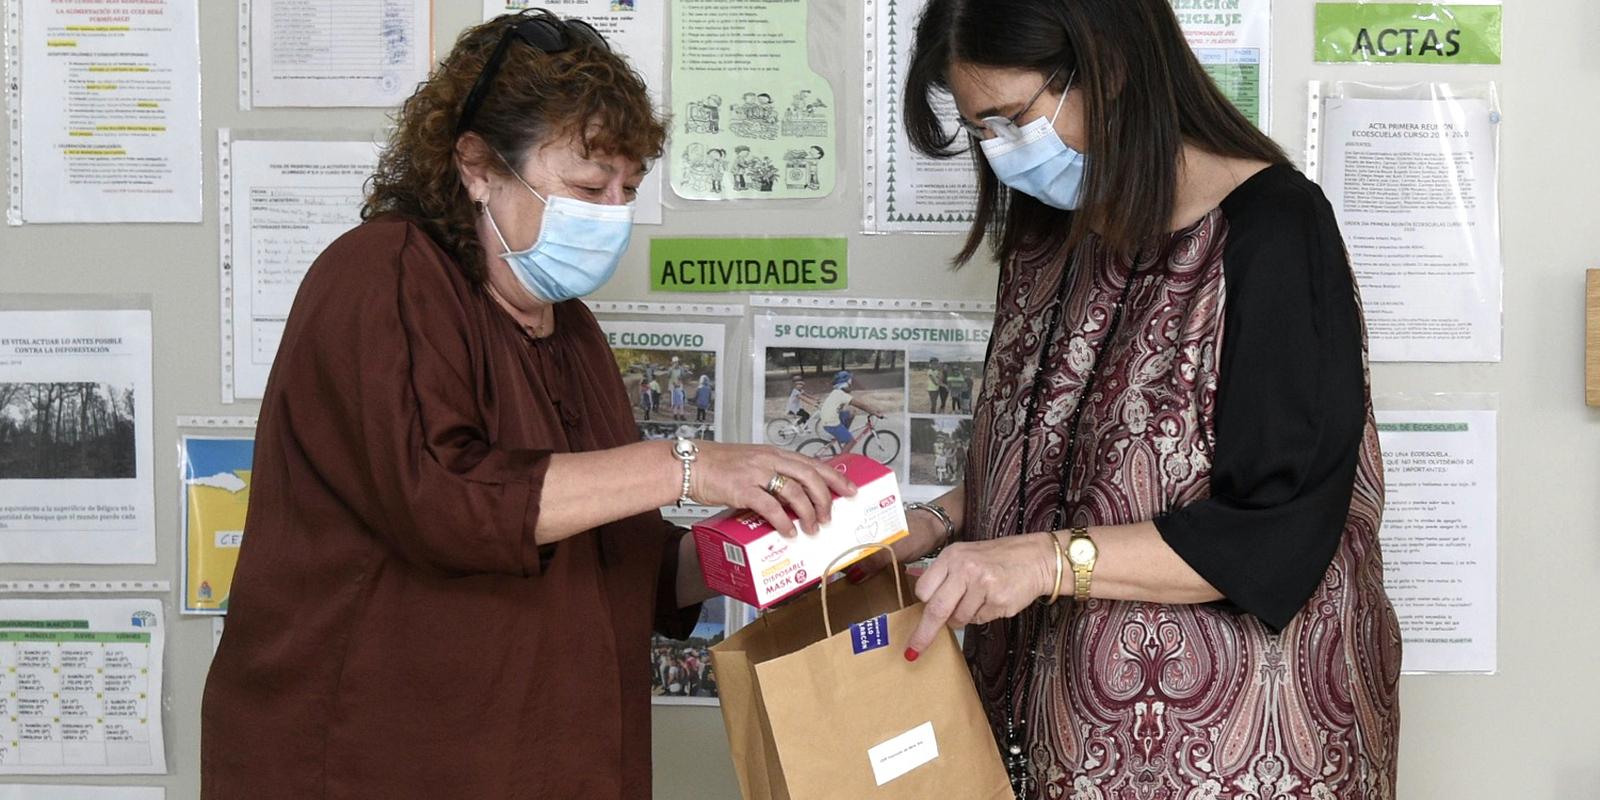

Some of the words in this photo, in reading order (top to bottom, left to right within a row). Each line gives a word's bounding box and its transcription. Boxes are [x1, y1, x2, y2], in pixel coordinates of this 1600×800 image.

[1352, 28, 1460, 56] ACTAS
[1352, 131, 1402, 139] ECOESCUELAS
[661, 260, 838, 284] ACTIVIDADES
[12, 337, 30, 345] VITAL
[32, 337, 59, 345] ACTUAR
[61, 337, 71, 345] LO
[72, 337, 94, 345] ANTES
[95, 337, 122, 345] POSIBLE
[621, 333, 704, 347] CLODOVEO
[775, 324, 791, 338] 5º
[892, 327, 989, 344] SOSTENIBLES
[1412, 423, 1468, 431] ECOESCUELAS
[763, 560, 804, 585] DISPOSABLE
[766, 576, 792, 594] MASK
